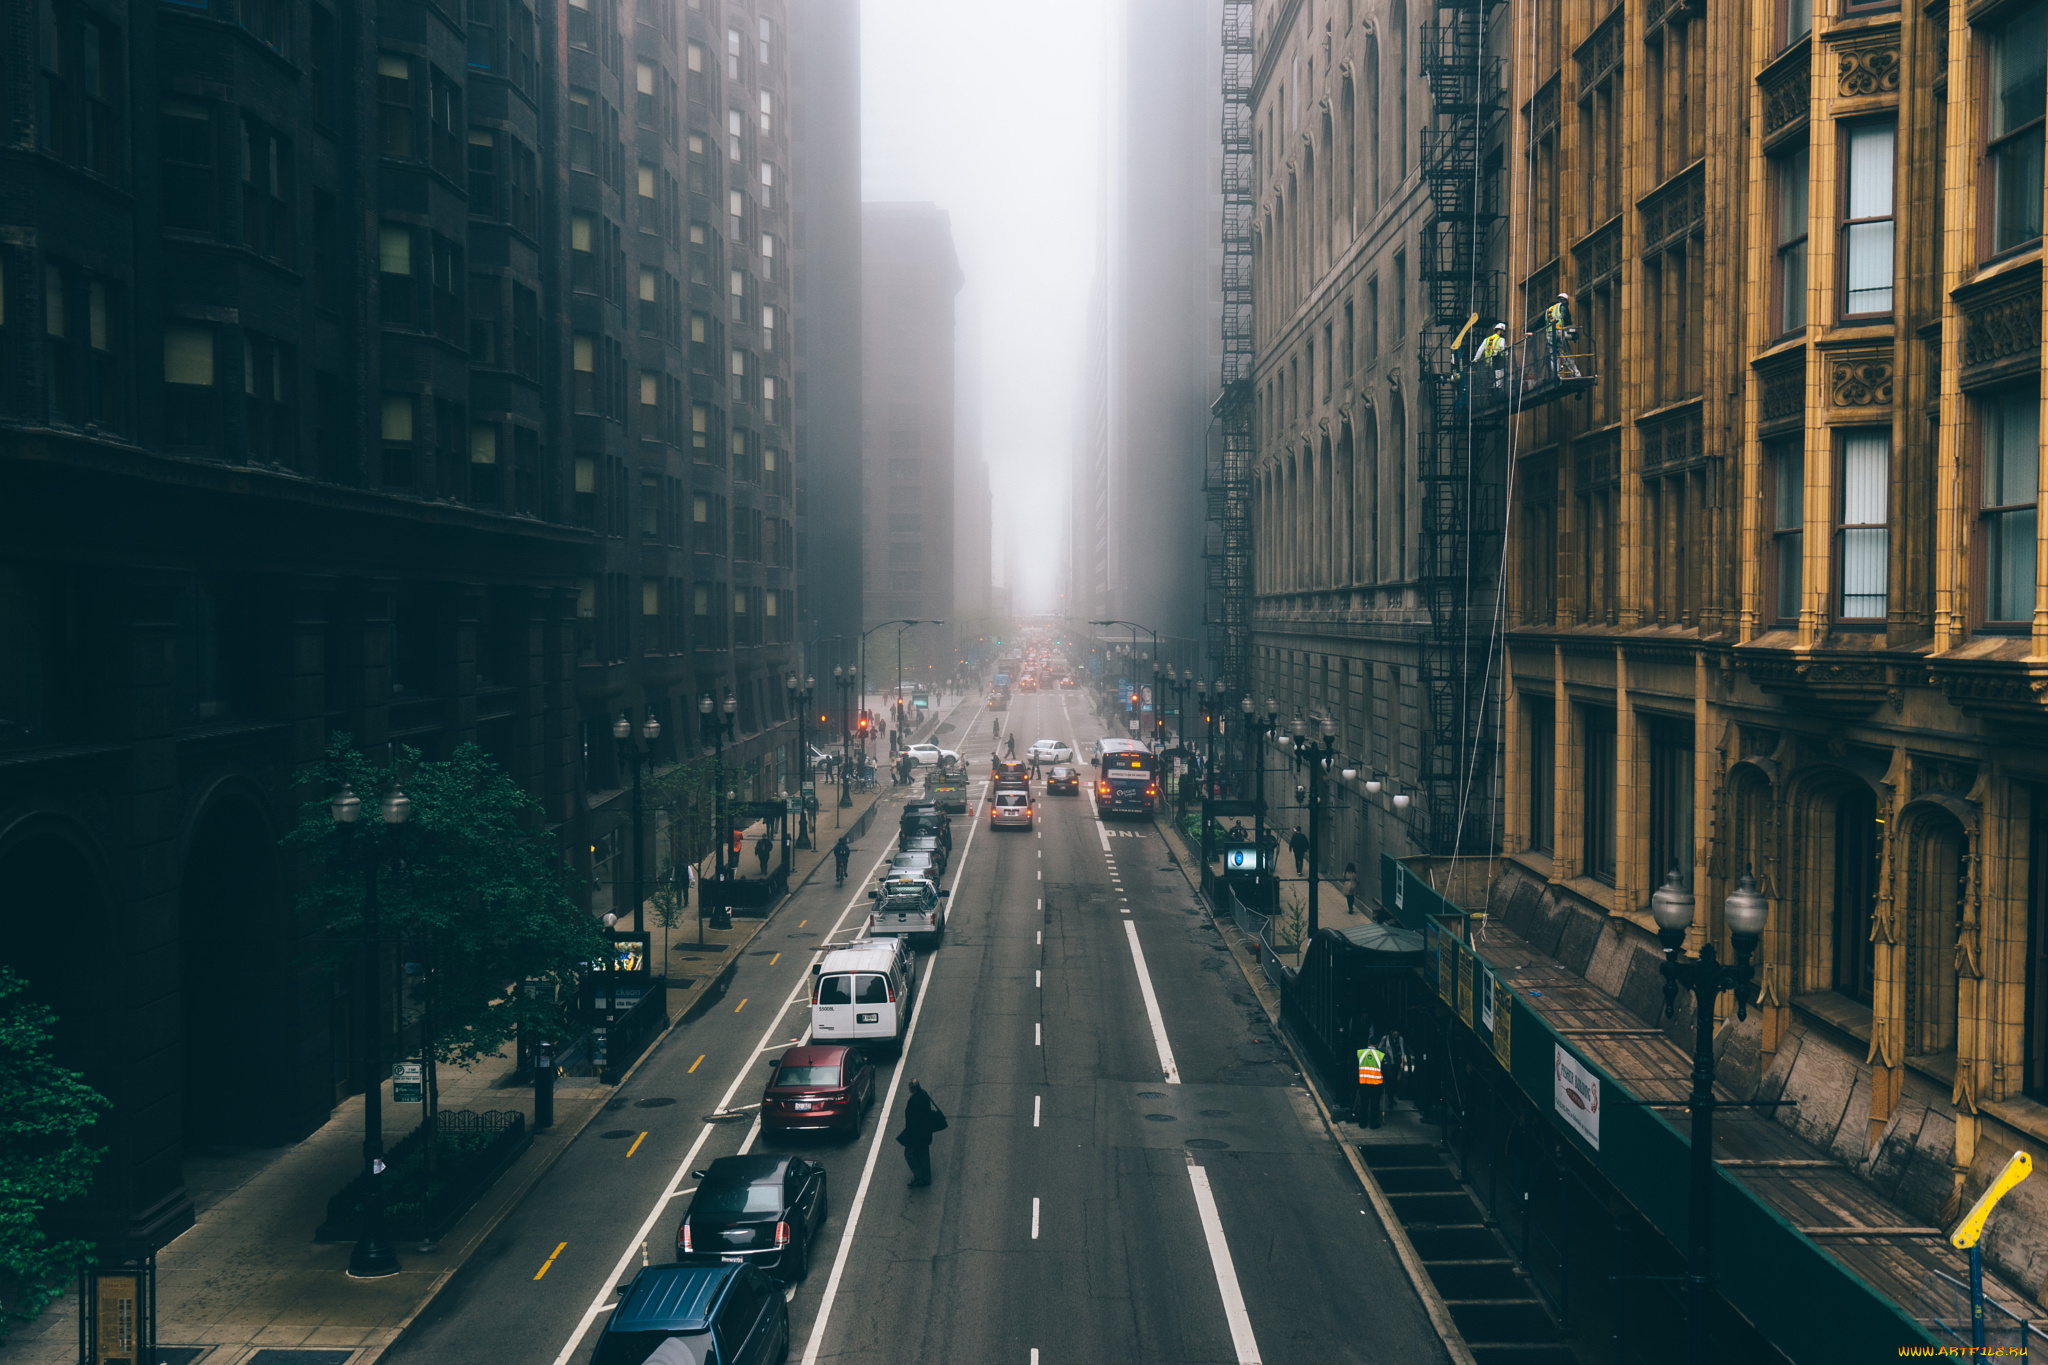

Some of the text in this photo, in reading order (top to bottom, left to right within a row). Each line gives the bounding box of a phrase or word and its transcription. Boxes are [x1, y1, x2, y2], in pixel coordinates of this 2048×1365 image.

[1105, 829, 1159, 838] ONL
[1561, 1063, 1574, 1085] FISHER
[1574, 1075, 1591, 1102] BUILDING
